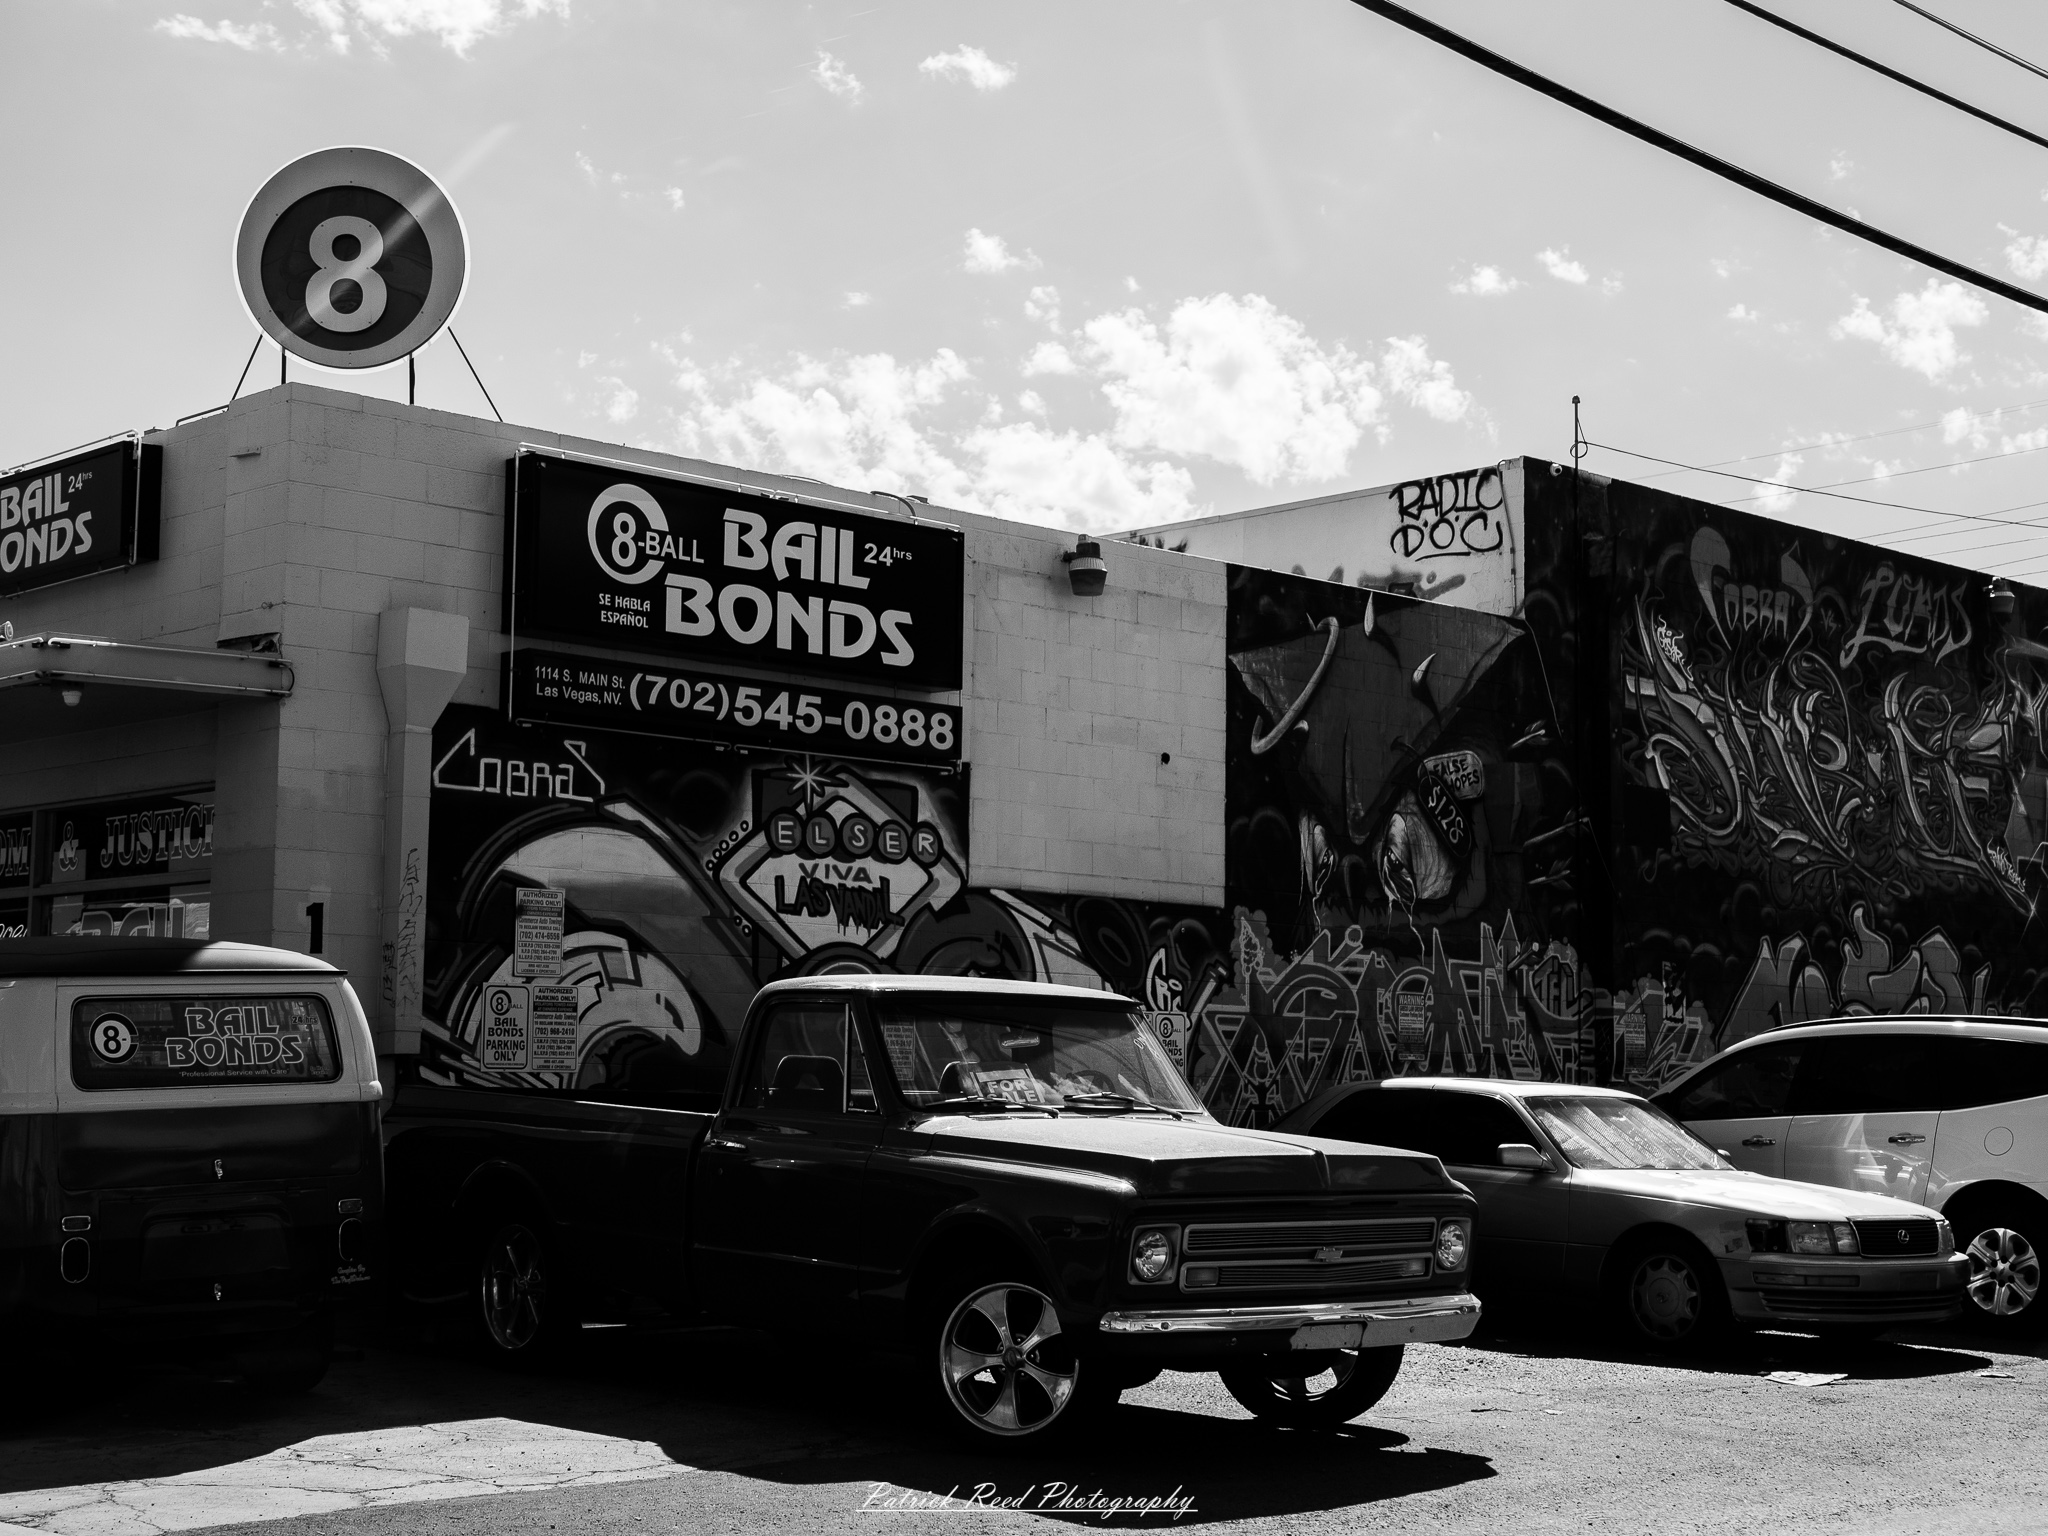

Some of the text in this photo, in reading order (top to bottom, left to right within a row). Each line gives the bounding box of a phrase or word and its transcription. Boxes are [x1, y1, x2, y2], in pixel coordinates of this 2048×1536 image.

[305, 215, 388, 333] 8
[0, 473, 70, 529] BAIL
[0, 511, 92, 573] ONDS
[722, 507, 872, 589] BAIL
[599, 593, 651, 612] SE HABLA
[601, 610, 649, 629] ESPAÑOL
[664, 572, 916, 666] BONDS
[535, 666, 626, 689] 1114 S. MAIN St.
[536, 683, 622, 706] Las Vegas, NV.
[59, 820, 80, 872] &
[777, 819, 936, 856] ELSER
[798, 862, 874, 884] VIVA
[523, 891, 559, 900] AUTHORIZED
[775, 874, 832, 917] LAS
[306, 902, 324, 954] 1
[520, 931, 534, 941] (702)
[1398, 995, 1425, 1006] WARNING
[185, 1005, 280, 1039] BAIL
[494, 1017, 518, 1027] BAIL
[535, 1012, 554, 1020] Commerce
[488, 1028, 524, 1037] BONDS
[535, 1027, 549, 1036] (702)
[165, 1034, 305, 1068] BONDS
[486, 1040, 526, 1051] PARKING
[493, 1050, 518, 1061] ONLY
[1168, 1048, 1182, 1056] NDS
[227, 1068, 253, 1077] Service
[255, 1068, 269, 1076] with
[986, 1078, 1028, 1094] FOR
